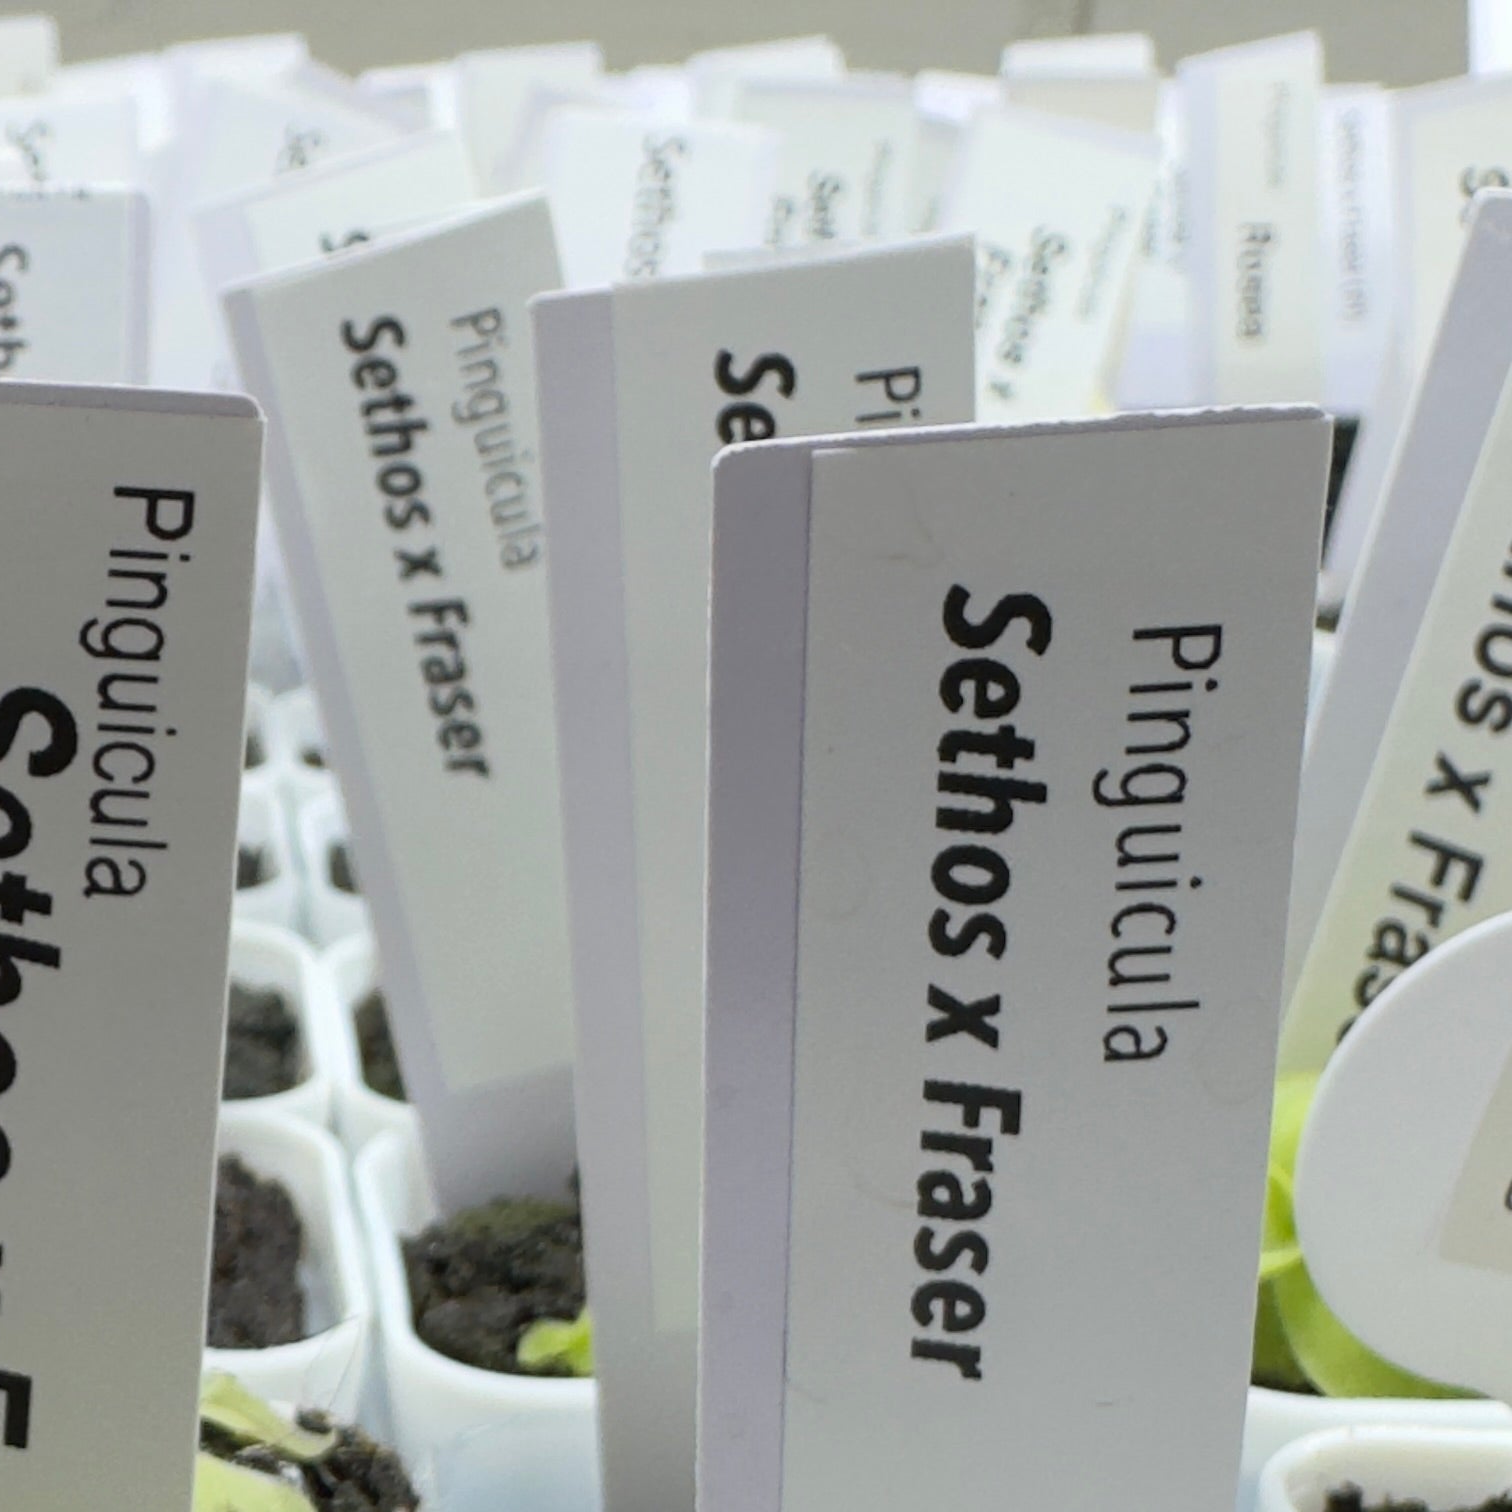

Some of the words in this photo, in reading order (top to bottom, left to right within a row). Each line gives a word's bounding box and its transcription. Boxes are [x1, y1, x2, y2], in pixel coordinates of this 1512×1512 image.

[341, 315, 431, 531] Sethos
[450, 306, 540, 572] Pinguicula
[394, 545, 443, 582] x
[79, 486, 195, 898] Pinguicula
[408, 598, 489, 779] Fraser
[928, 583, 1053, 961] Sethos
[1426, 752, 1491, 814] x
[1092, 624, 1223, 1062] Pinguicula
[1336, 831, 1484, 1043] Fras
[926, 983, 1002, 1050] x
[910, 1079, 1022, 1381] Fraser
